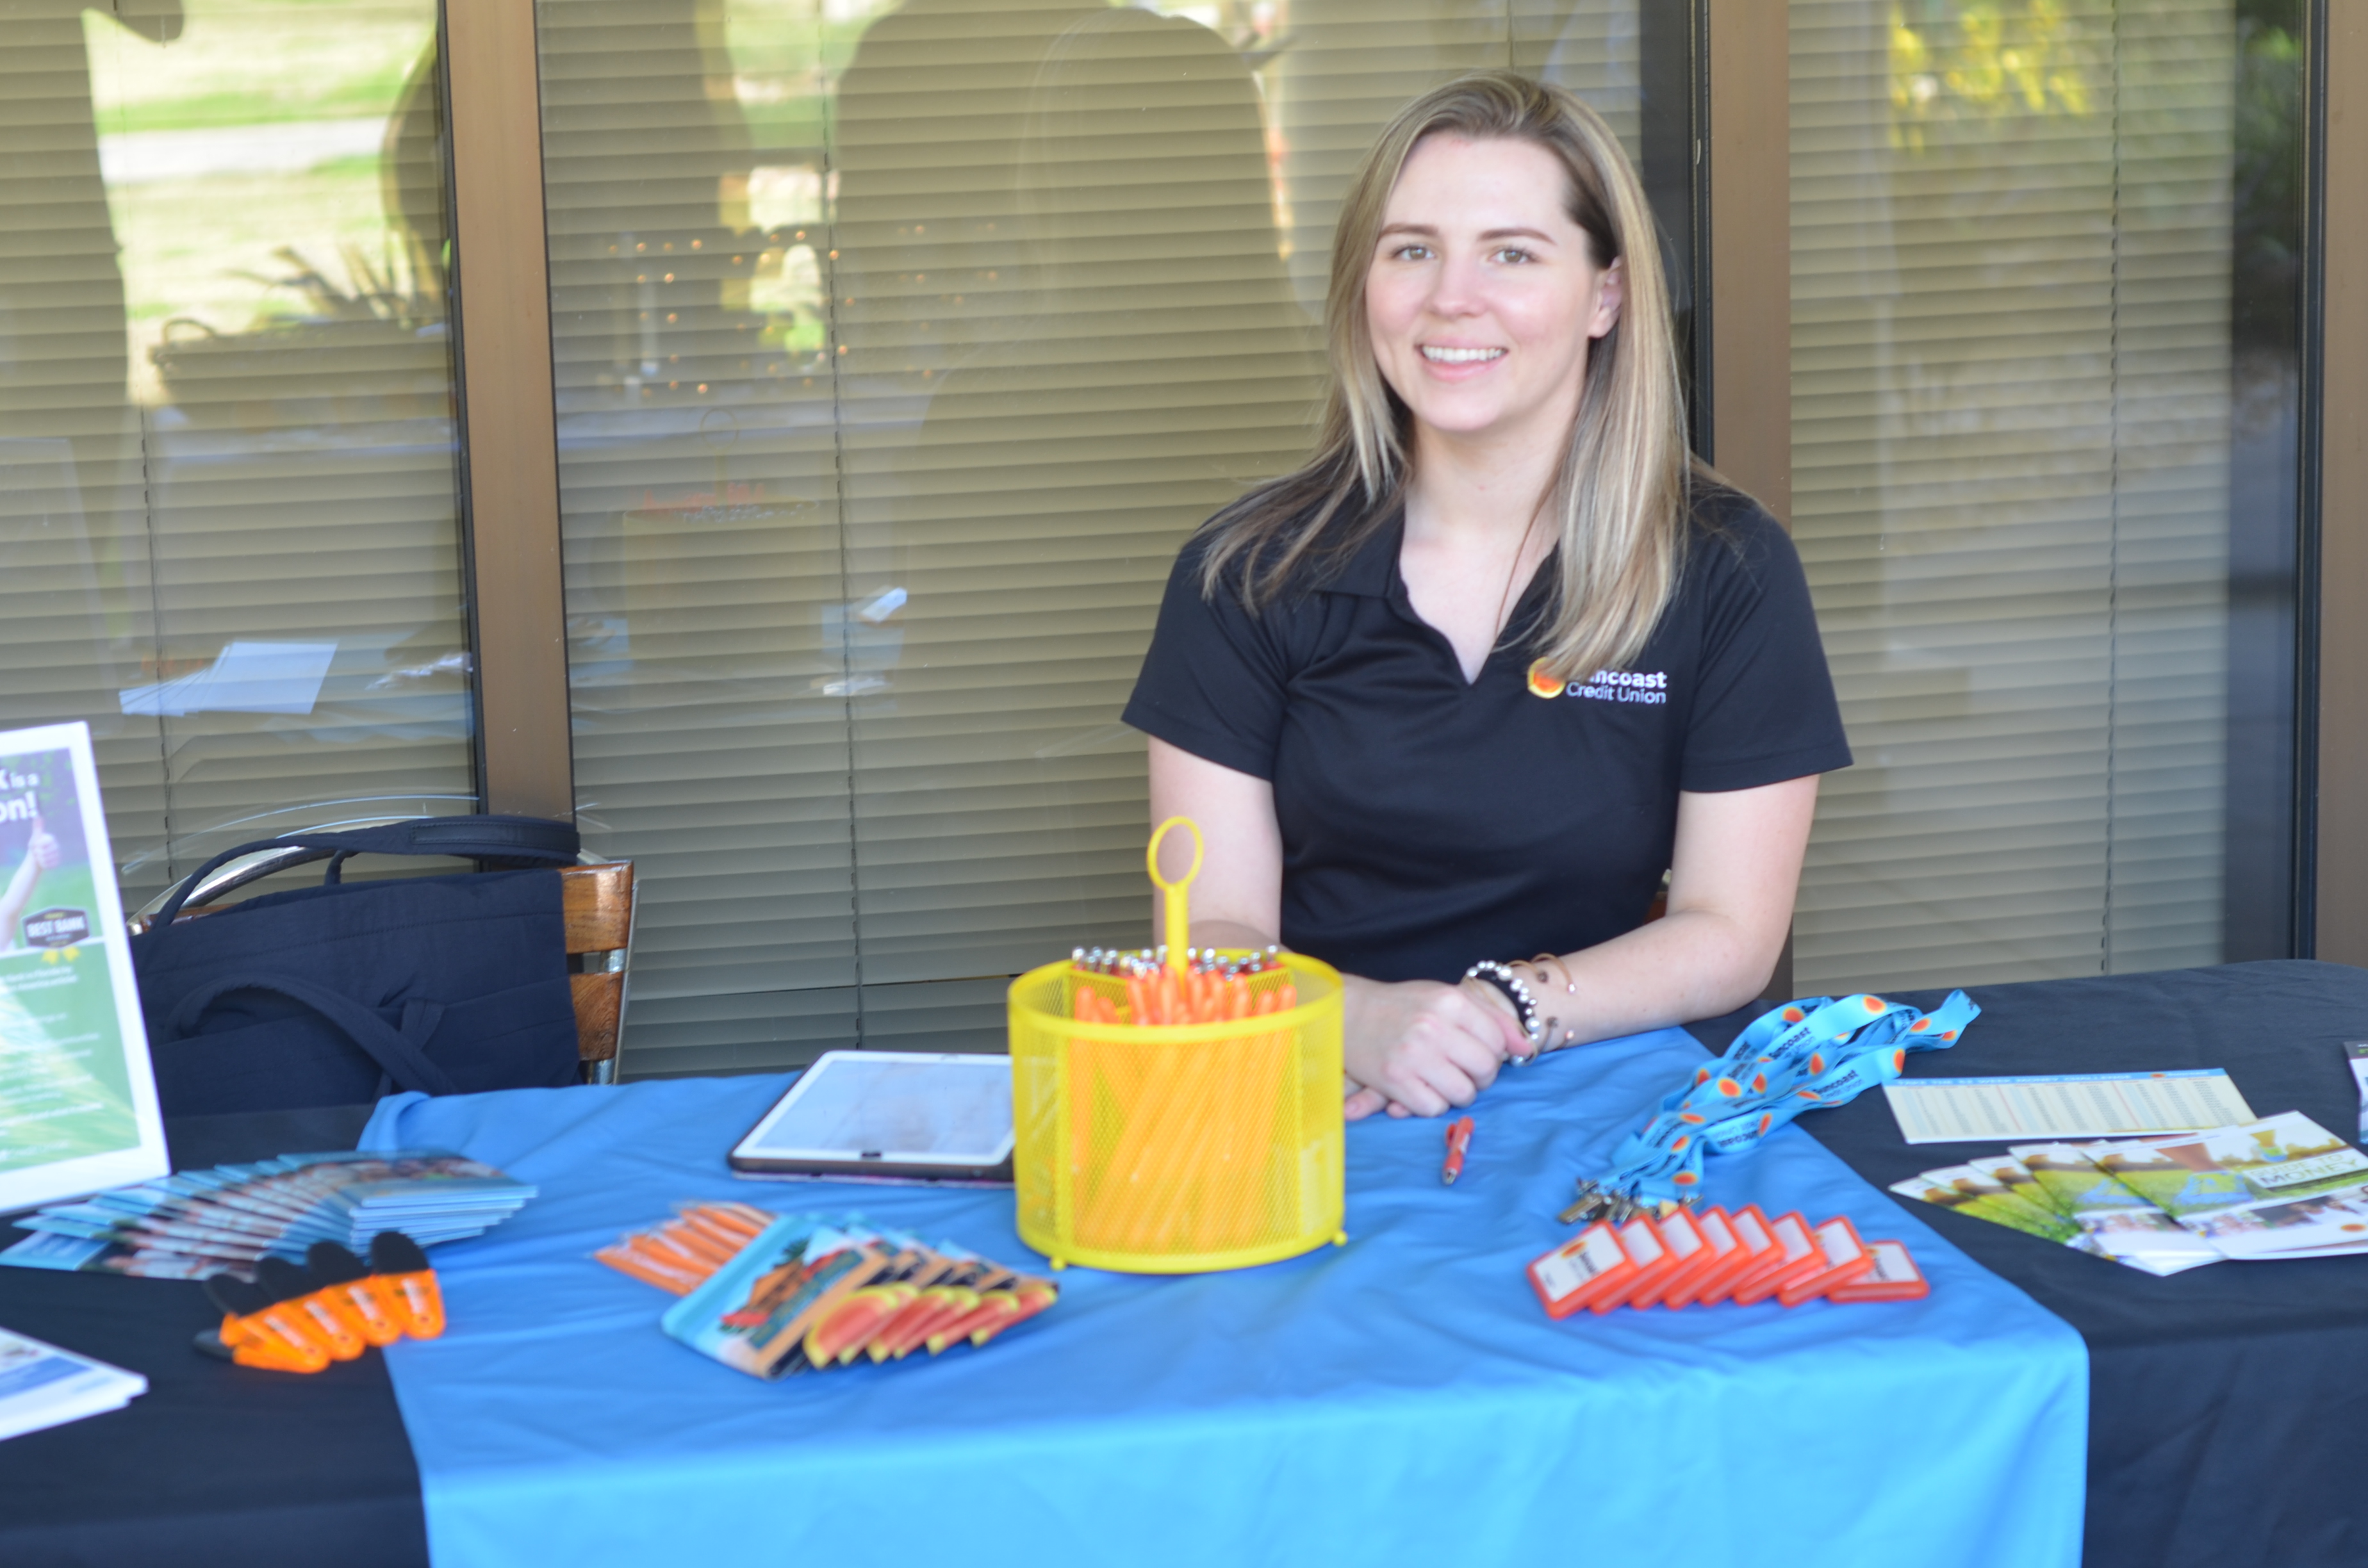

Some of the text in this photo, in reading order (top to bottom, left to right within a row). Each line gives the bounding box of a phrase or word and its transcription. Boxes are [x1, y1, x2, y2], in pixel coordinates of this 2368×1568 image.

[1588, 669, 1668, 689] ncoast
[1566, 682, 1667, 704] Credit Union
[27, 920, 53, 938] BEST
[54, 916, 85, 933] BANK
[2250, 1154, 2344, 1177] GUIDE TO
[2259, 1158, 2358, 1185] MONEY
